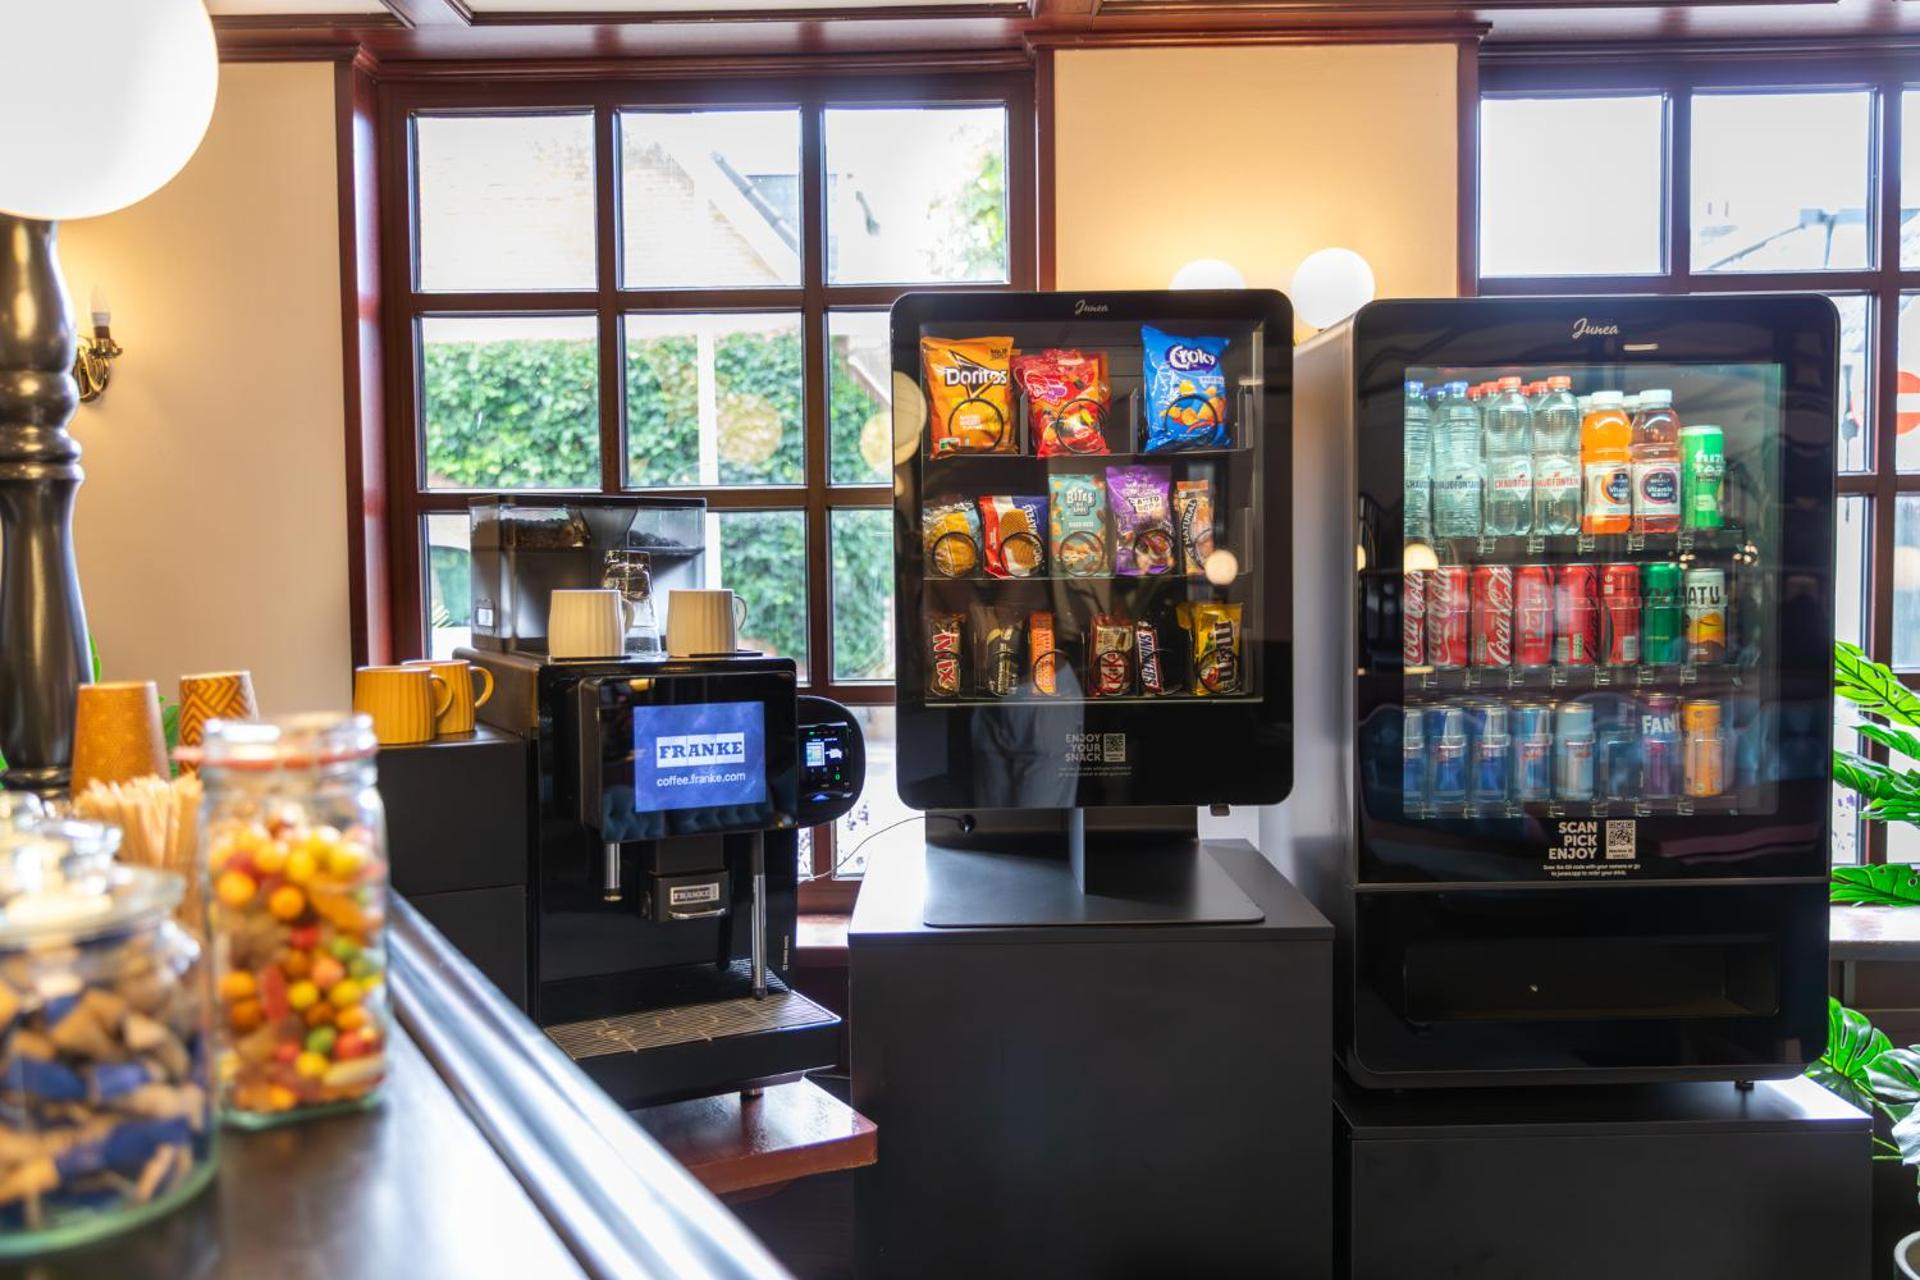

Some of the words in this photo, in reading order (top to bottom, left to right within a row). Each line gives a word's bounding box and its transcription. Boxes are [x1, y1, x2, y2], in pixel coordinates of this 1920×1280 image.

[1572, 318, 1618, 339] Junea
[1169, 346, 1216, 370] Croky
[944, 366, 1008, 386] Doritos
[1182, 500, 1197, 545] NATURAL
[1138, 634, 1158, 686] SNICKERS
[1065, 733, 1100, 743] ENJOY
[659, 741, 743, 759] FRANKE
[1072, 743, 1100, 752] YOUR
[1065, 753, 1101, 762] SNACK
[657, 771, 746, 787] coffee.franke.com
[1558, 821, 1598, 834] SCAN
[1563, 834, 1598, 847] PICK
[1548, 847, 1598, 860] ENJOY
